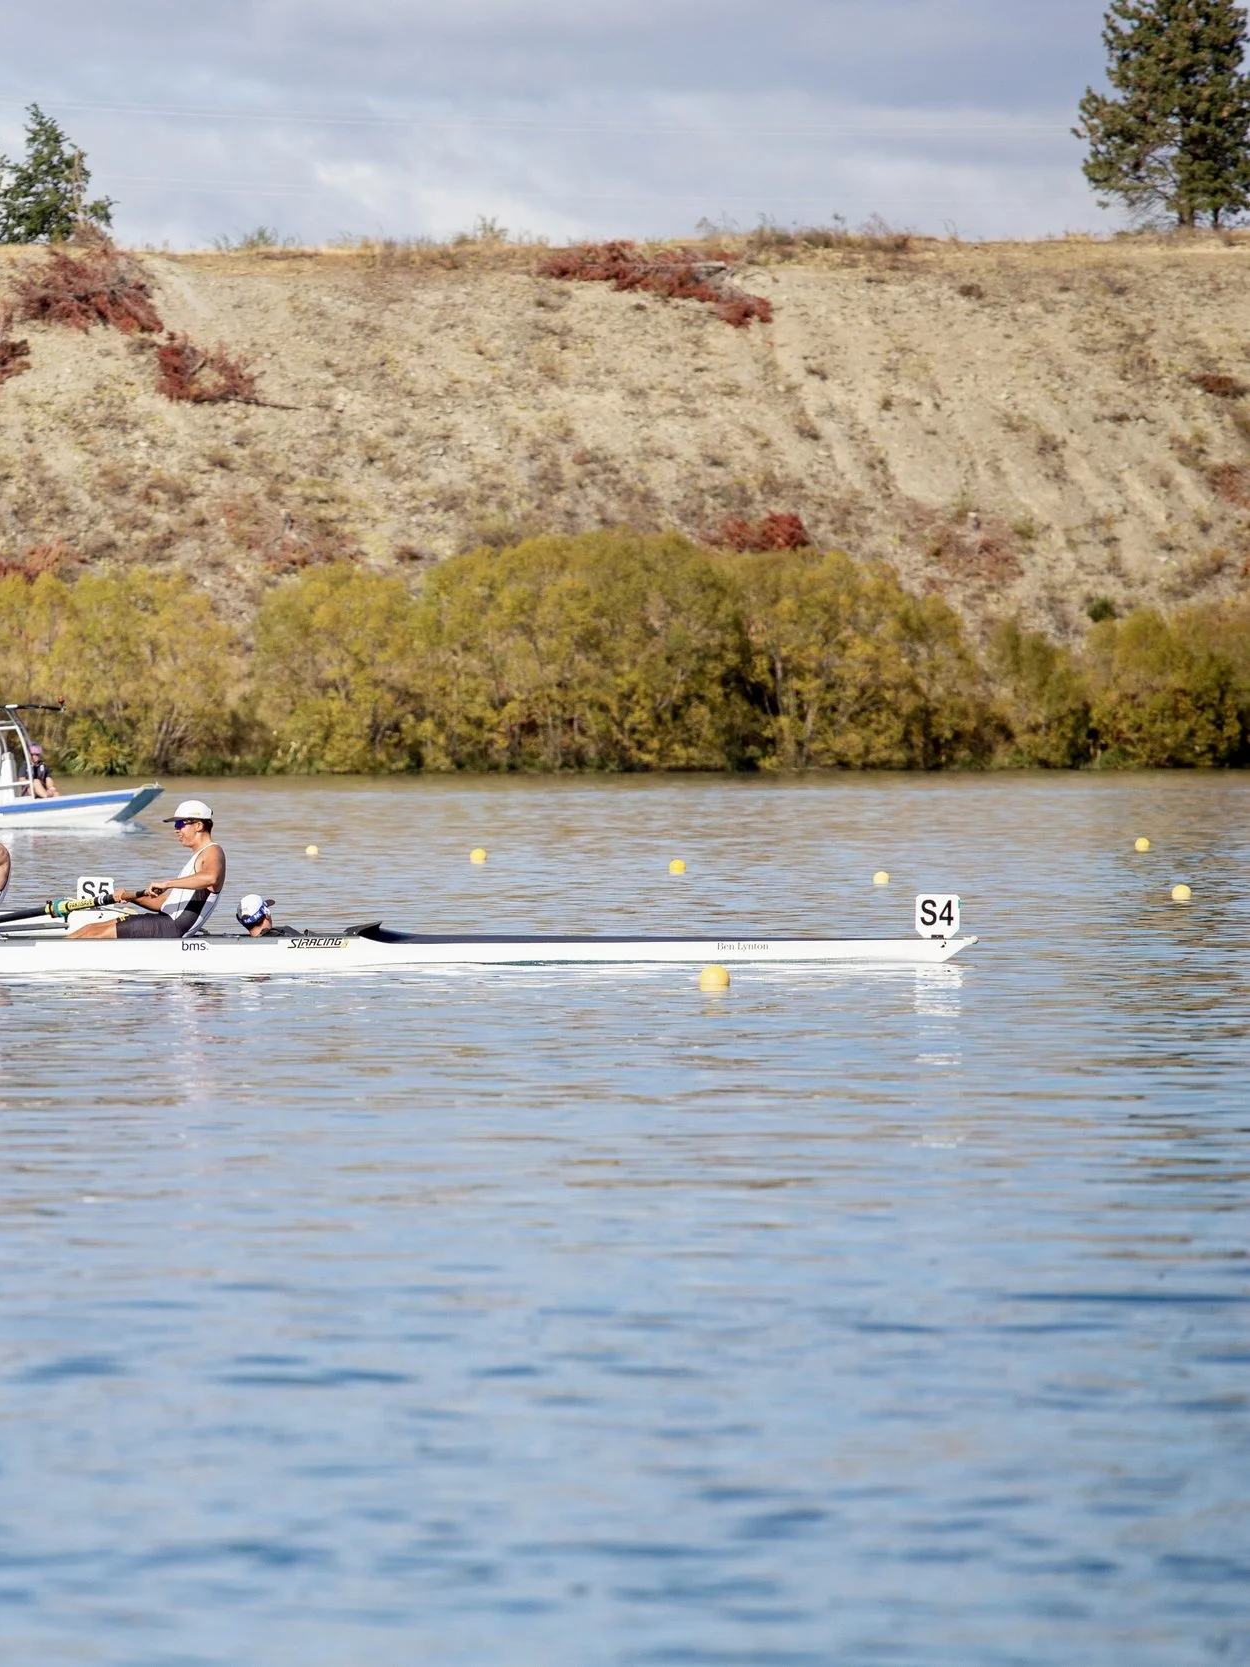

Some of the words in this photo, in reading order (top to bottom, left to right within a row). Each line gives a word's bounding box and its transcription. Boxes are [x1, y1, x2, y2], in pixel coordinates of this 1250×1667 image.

[920, 899, 954, 927] S4
[717, 942, 735, 951] Ben
[737, 942, 769, 952] Lynton
